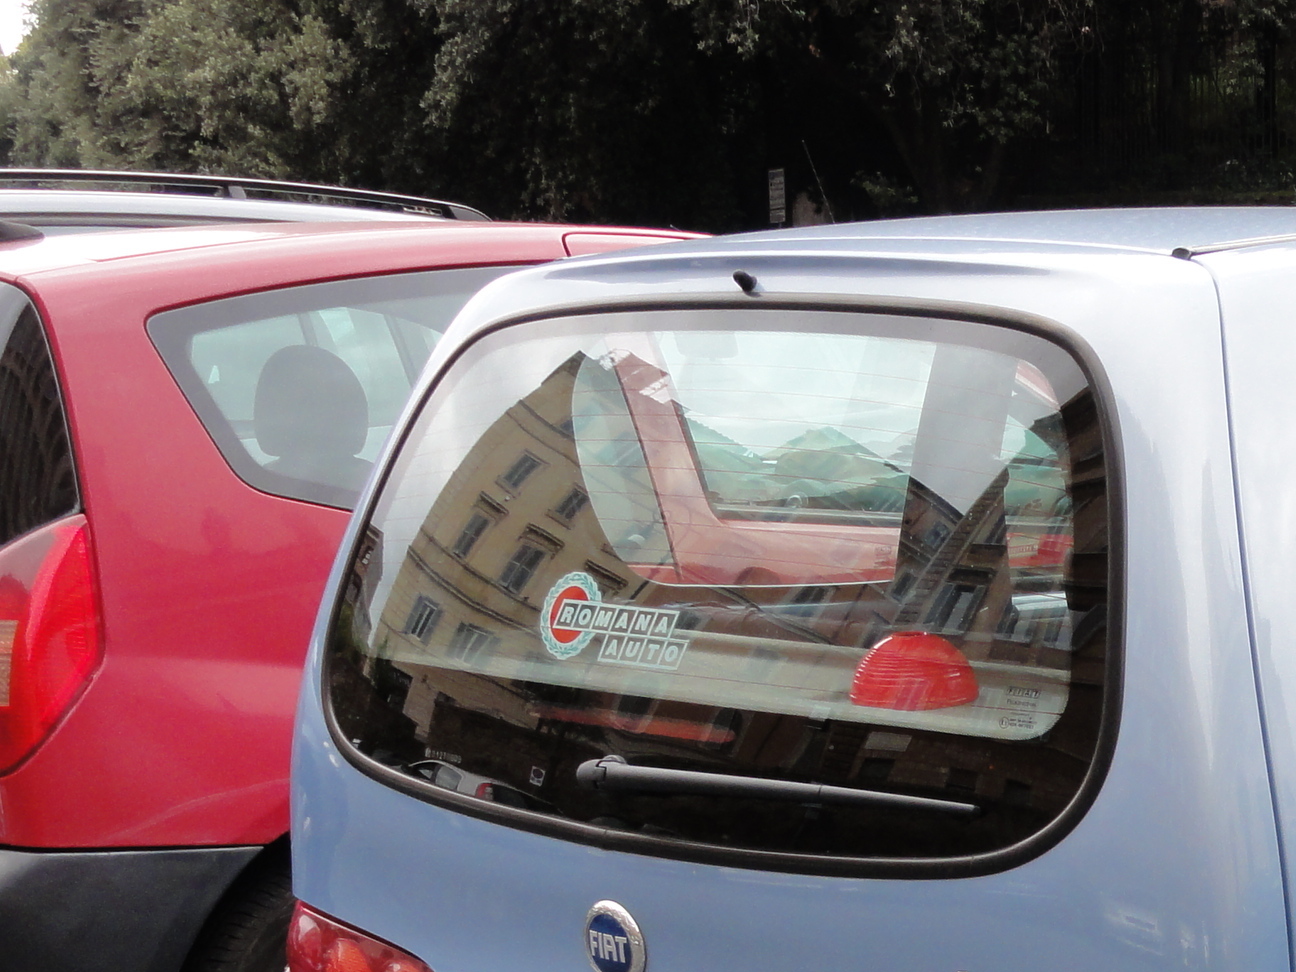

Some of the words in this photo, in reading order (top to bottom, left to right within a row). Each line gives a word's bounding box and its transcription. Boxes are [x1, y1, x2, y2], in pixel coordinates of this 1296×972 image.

[560, 606, 668, 634] ROMANA
[605, 639, 679, 662] AUTO
[589, 929, 627, 964] FIAT
